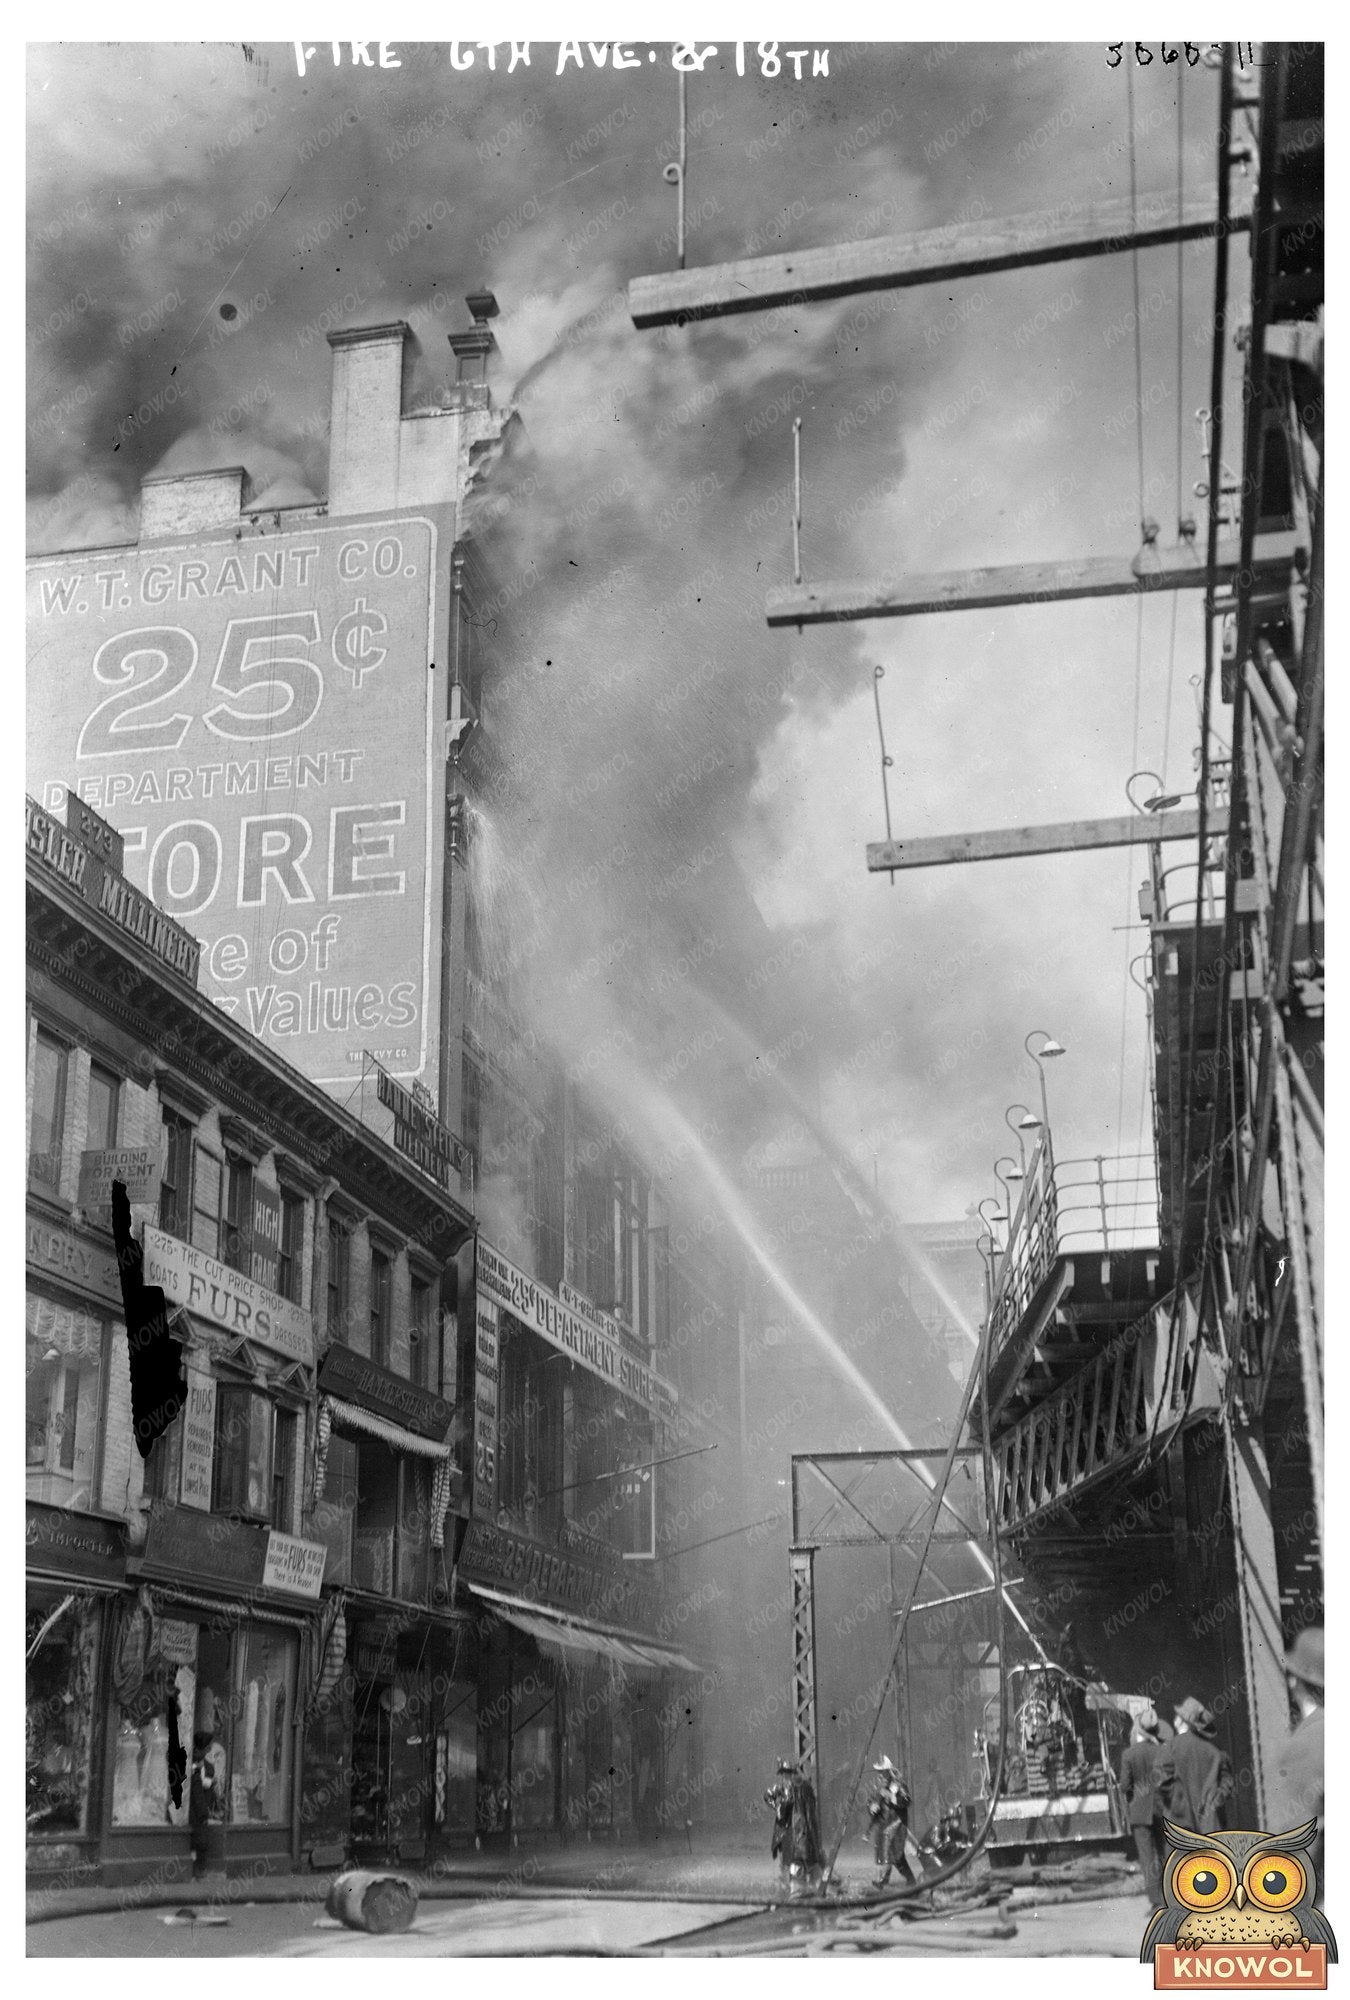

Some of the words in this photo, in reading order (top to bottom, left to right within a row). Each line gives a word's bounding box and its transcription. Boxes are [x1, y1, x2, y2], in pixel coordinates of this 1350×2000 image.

[140, 546, 321, 604] GRANT
[337, 537, 417, 582] CO.
[43, 748, 366, 814] DEPARTMENT
[80, 810, 114, 854] 273
[98, 870, 200, 979] MILLINERY
[269, 914, 342, 975] of
[246, 980, 418, 1037] Values
[395, 1048, 409, 1059] CO.
[93, 1151, 148, 1166] BUILDING
[116, 1163, 156, 1178] RENT
[254, 1199, 279, 1244] HIGH
[149, 1261, 179, 1291] COATS
[181, 1246, 199, 1269] THE
[204, 1259, 225, 1282] CUT
[228, 1272, 255, 1300] PRICE
[259, 1290, 284, 1313] SHOP
[252, 1251, 278, 1293] GRADE
[186, 1271, 271, 1341] FURS
[536, 1290, 615, 1380] DEPARTMENT
[619, 1354, 655, 1403] STORE
[190, 1386, 213, 1416] FURS
[49, 1531, 114, 1556] IMPORTER
[287, 1545, 308, 1574] FURS
